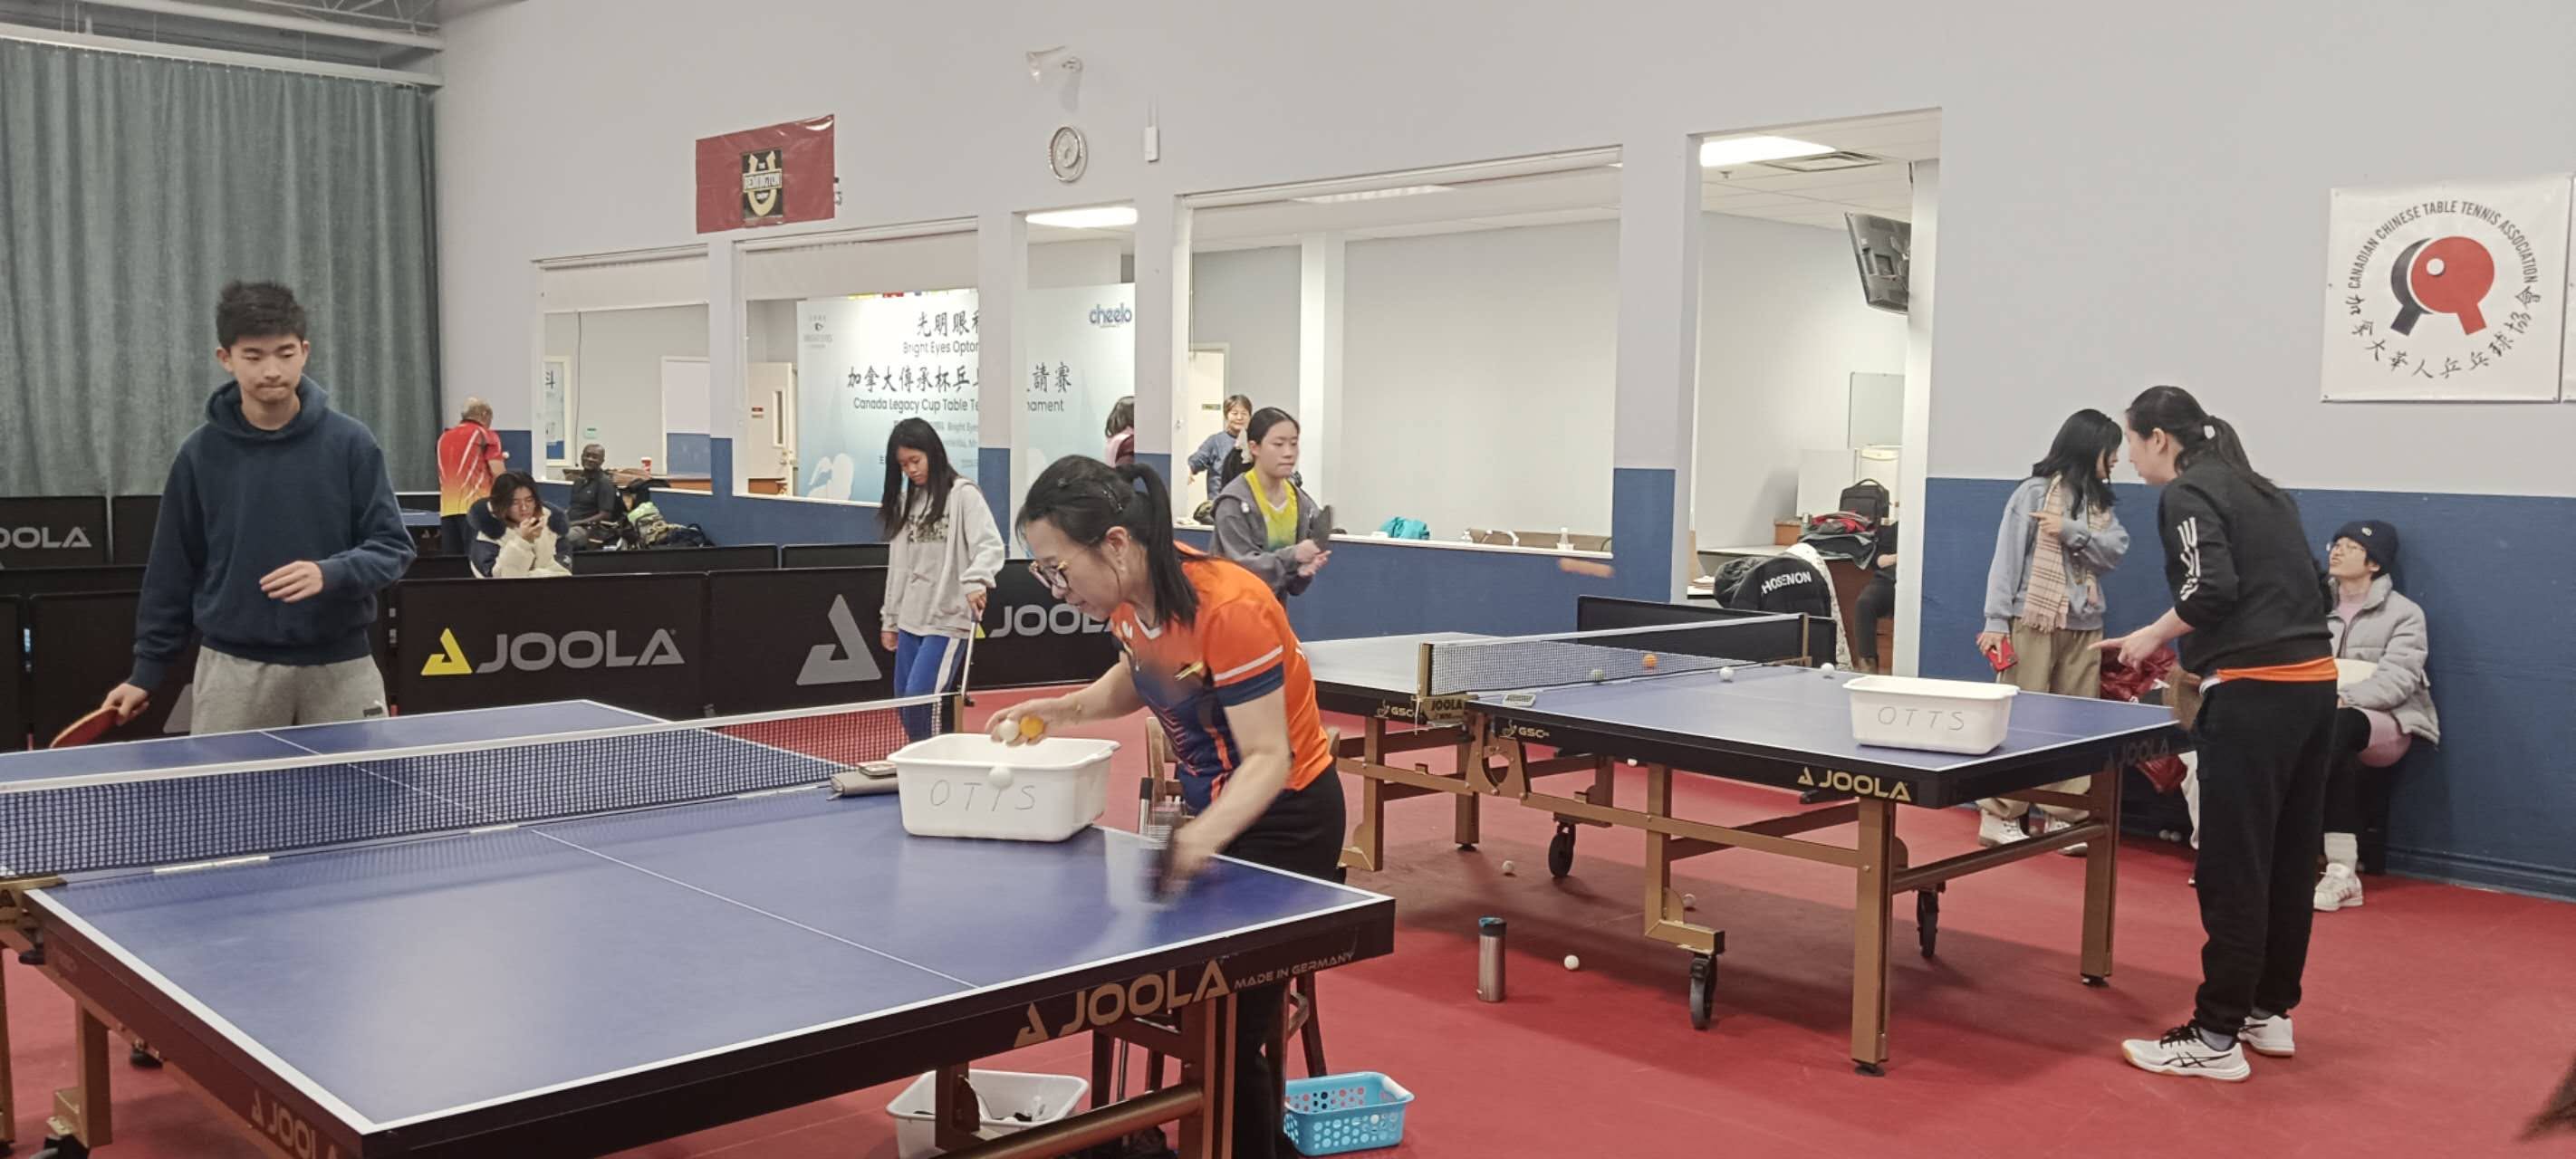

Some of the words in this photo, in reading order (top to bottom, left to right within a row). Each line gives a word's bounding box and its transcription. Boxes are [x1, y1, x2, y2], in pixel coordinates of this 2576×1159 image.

[2348, 237, 2379, 289] CANADIAN
[2375, 206, 2422, 240] CHINESE
[2422, 200, 2459, 216] TABLE
[2461, 201, 2501, 225] TENNIS
[2497, 219, 2539, 283] ASSOCIATION
[1089, 302, 1132, 324] cheelo
[902, 341, 928, 358] Bright
[930, 341, 951, 356] Eyes
[1026, 361, 1072, 393] 請賽
[853, 397, 888, 410] Canada
[889, 398, 920, 414] Legacy
[921, 398, 941, 414] Cup
[942, 398, 968, 411] Table
[988, 603, 1112, 637] JOOL
[476, 628, 686, 674] JOOLA
[1877, 706, 1965, 731] OTTS
[1819, 770, 1912, 802] JOOLA
[1234, 971, 1274, 990] MADE
[1276, 968, 1289, 979] IN
[1291, 952, 1355, 975] GERMANY
[1058, 959, 1231, 1038] JOOLA
